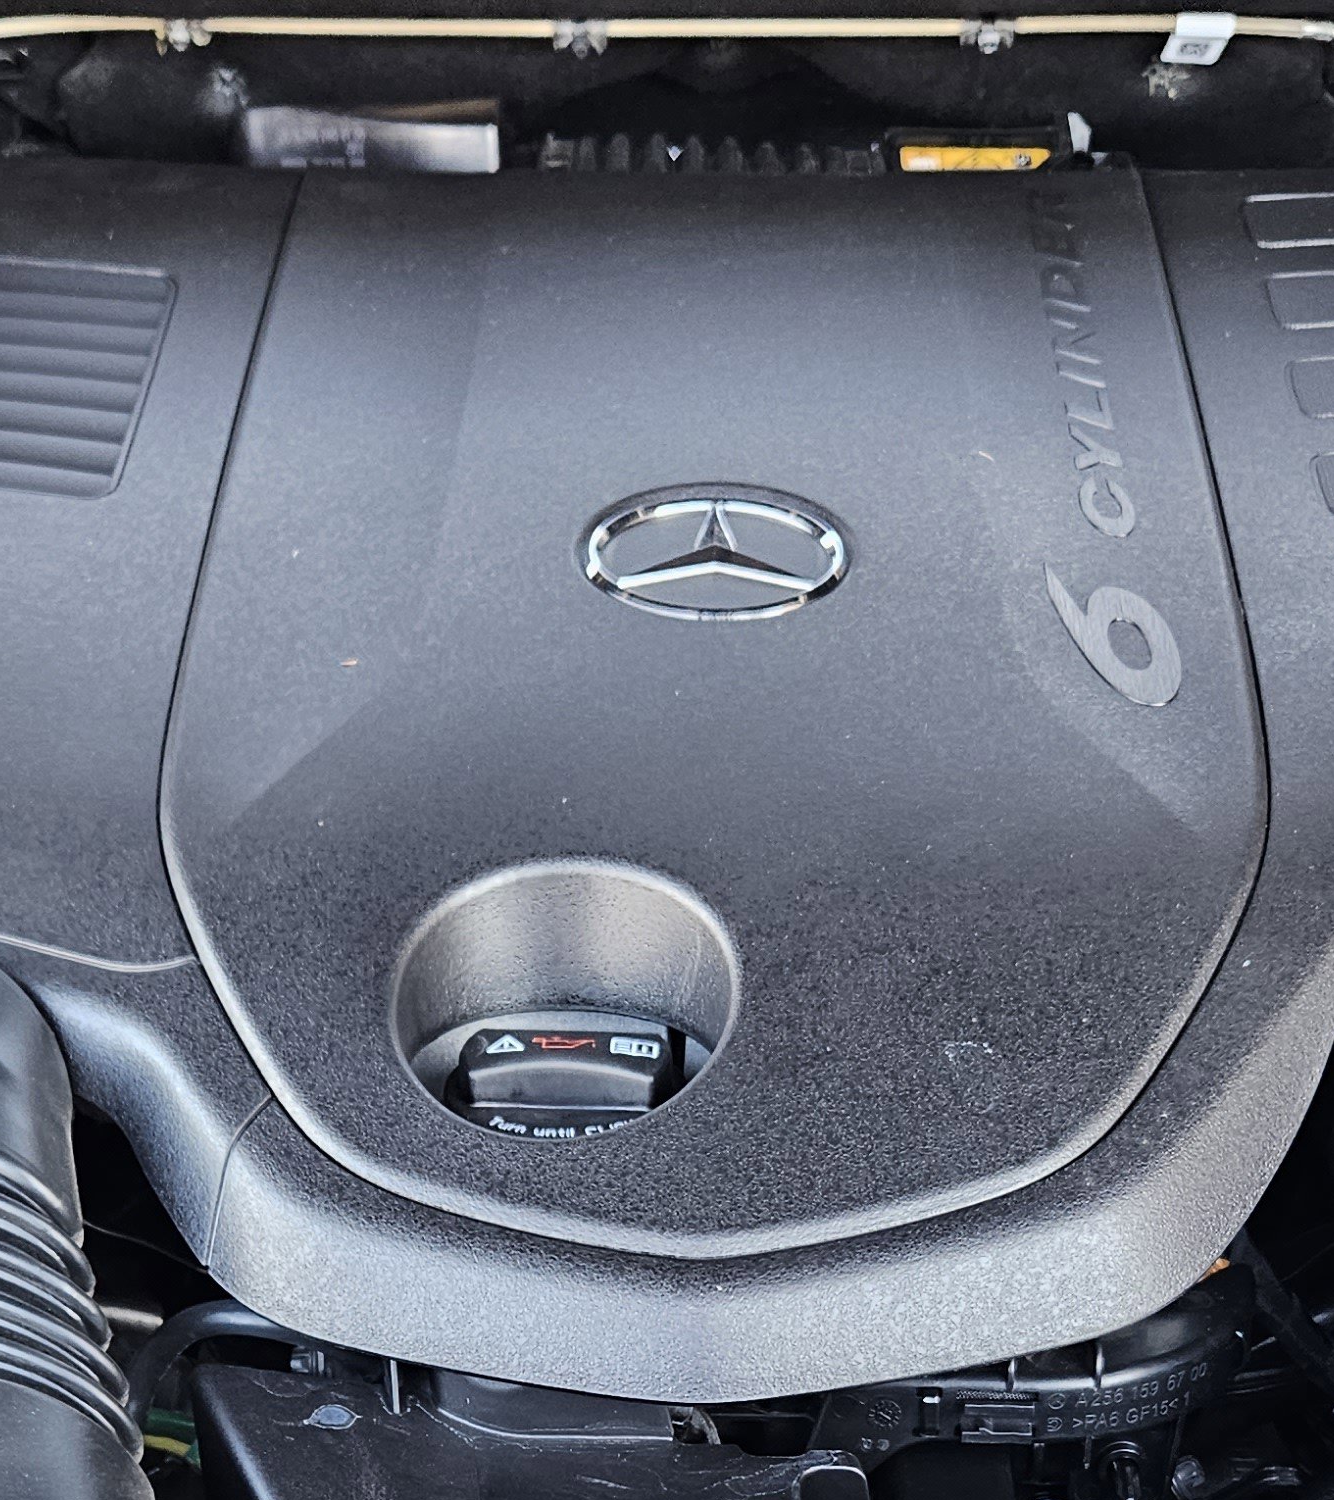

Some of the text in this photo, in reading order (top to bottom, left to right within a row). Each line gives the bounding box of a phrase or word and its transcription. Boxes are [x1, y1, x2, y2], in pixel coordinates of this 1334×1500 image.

[1043, 563, 1181, 706] 6
[489, 1115, 527, 1134] Turn
[534, 1126, 576, 1138] until
[1131, 1380, 1159, 1399] 159
[1167, 1371, 1185, 1391] 67
[1190, 1362, 1208, 1381] 00
